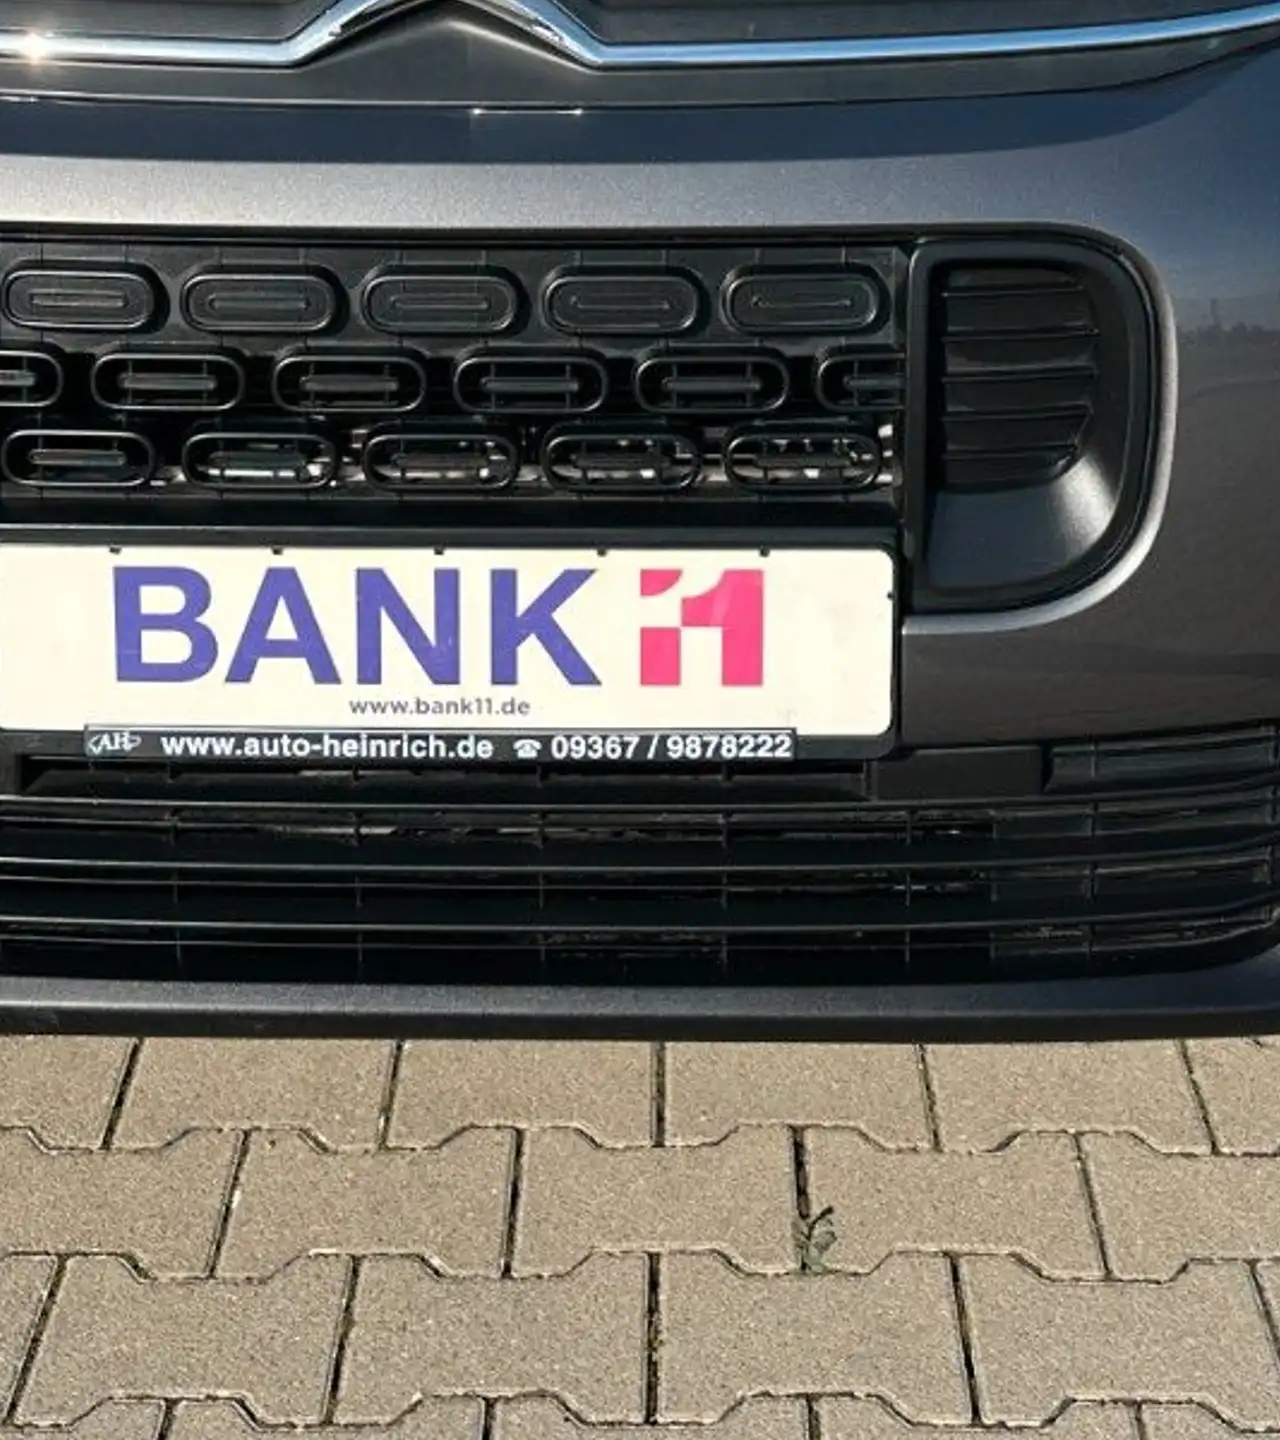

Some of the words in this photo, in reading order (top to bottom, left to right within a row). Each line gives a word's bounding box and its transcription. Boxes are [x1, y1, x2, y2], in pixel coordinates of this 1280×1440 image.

[113, 566, 602, 687] BANK
[639, 568, 763, 688] 11
[349, 696, 531, 717] www.bank11.de
[160, 733, 494, 758] www.auto-heinrich.de
[550, 735, 639, 760] 09367
[647, 735, 661, 759] /
[666, 734, 792, 759] 9878222
